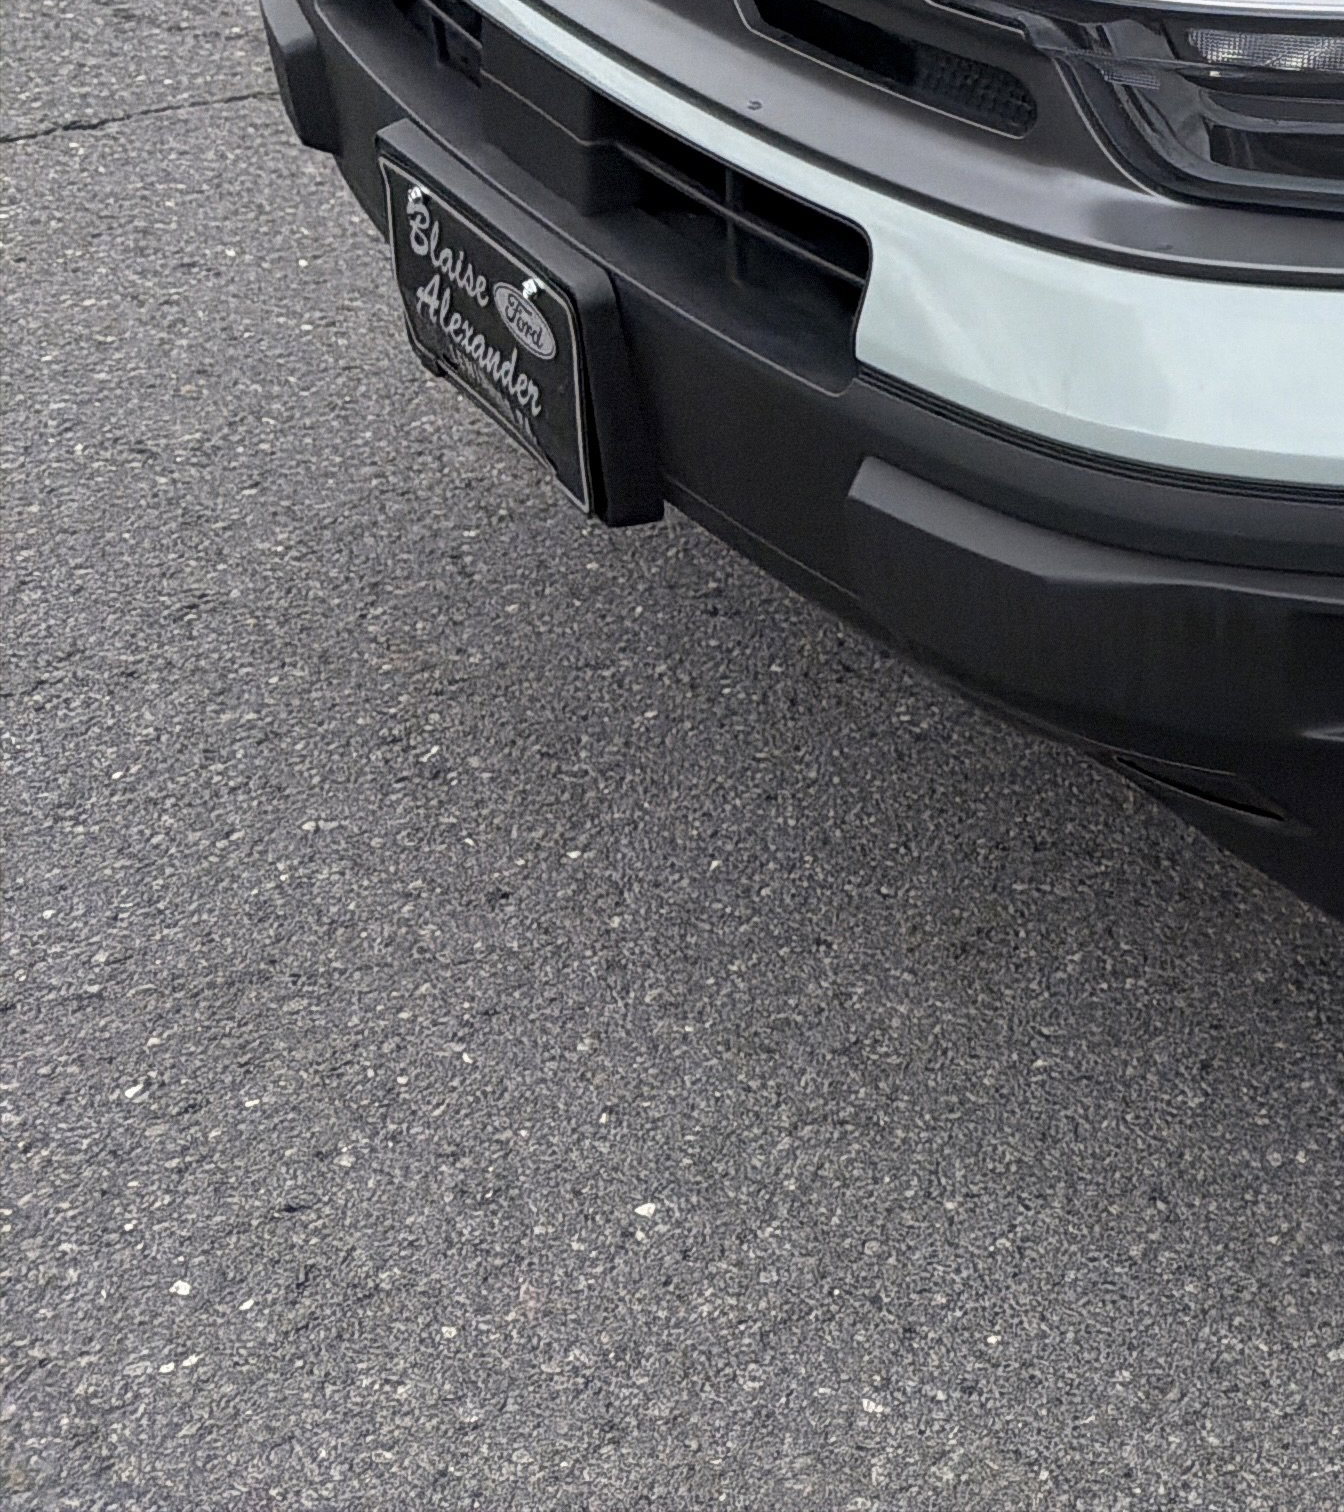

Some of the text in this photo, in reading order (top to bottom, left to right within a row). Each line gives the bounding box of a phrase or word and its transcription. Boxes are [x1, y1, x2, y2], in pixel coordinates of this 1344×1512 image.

[406, 191, 490, 308] Blaise
[415, 273, 542, 418] Alexander
[504, 291, 544, 351] Ford
